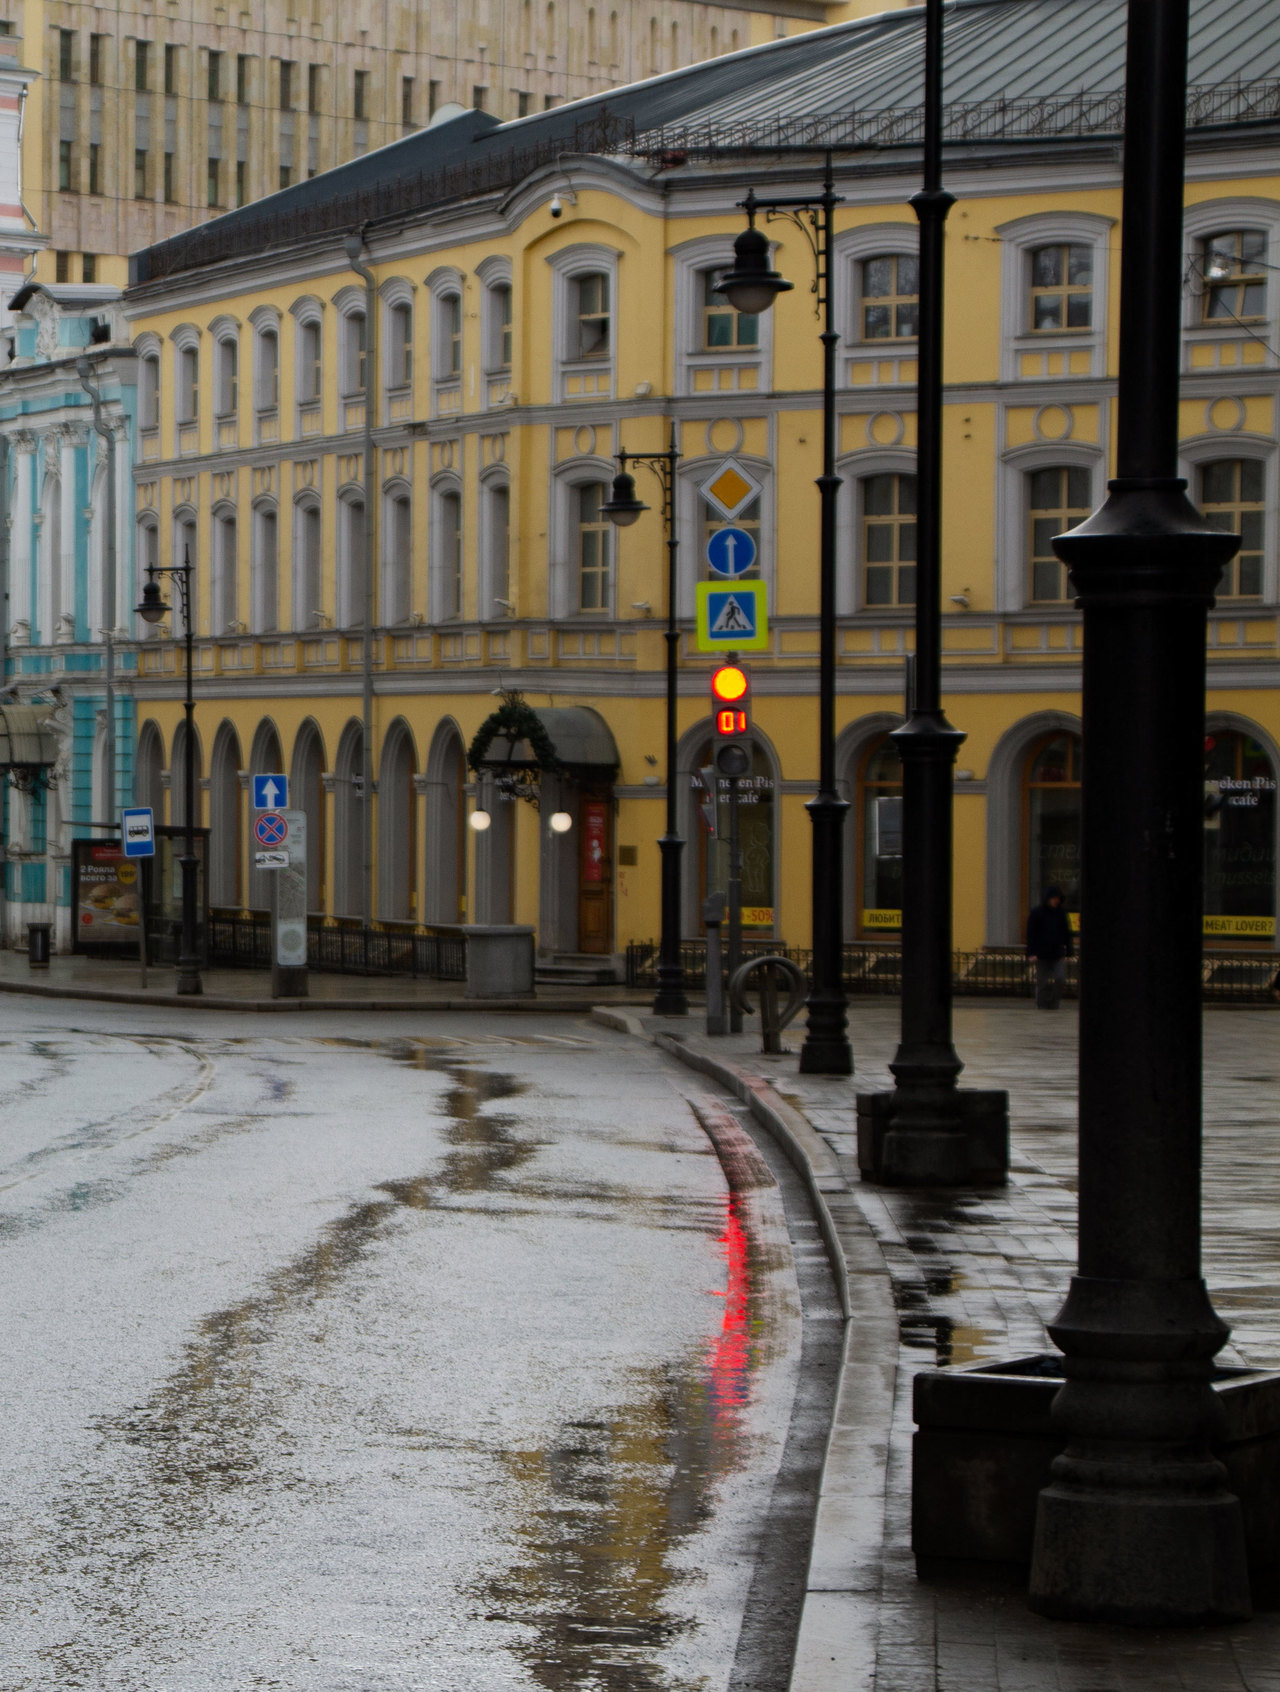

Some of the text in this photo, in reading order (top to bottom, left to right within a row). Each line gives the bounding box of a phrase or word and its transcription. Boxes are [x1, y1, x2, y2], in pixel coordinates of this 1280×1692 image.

[718, 710, 747, 735] 01
[756, 776, 774, 789] Pis
[1255, 776, 1276, 790] Pis
[1231, 792, 1259, 806] cafe
[1205, 920, 1273, 932] MEAT LOVER?
